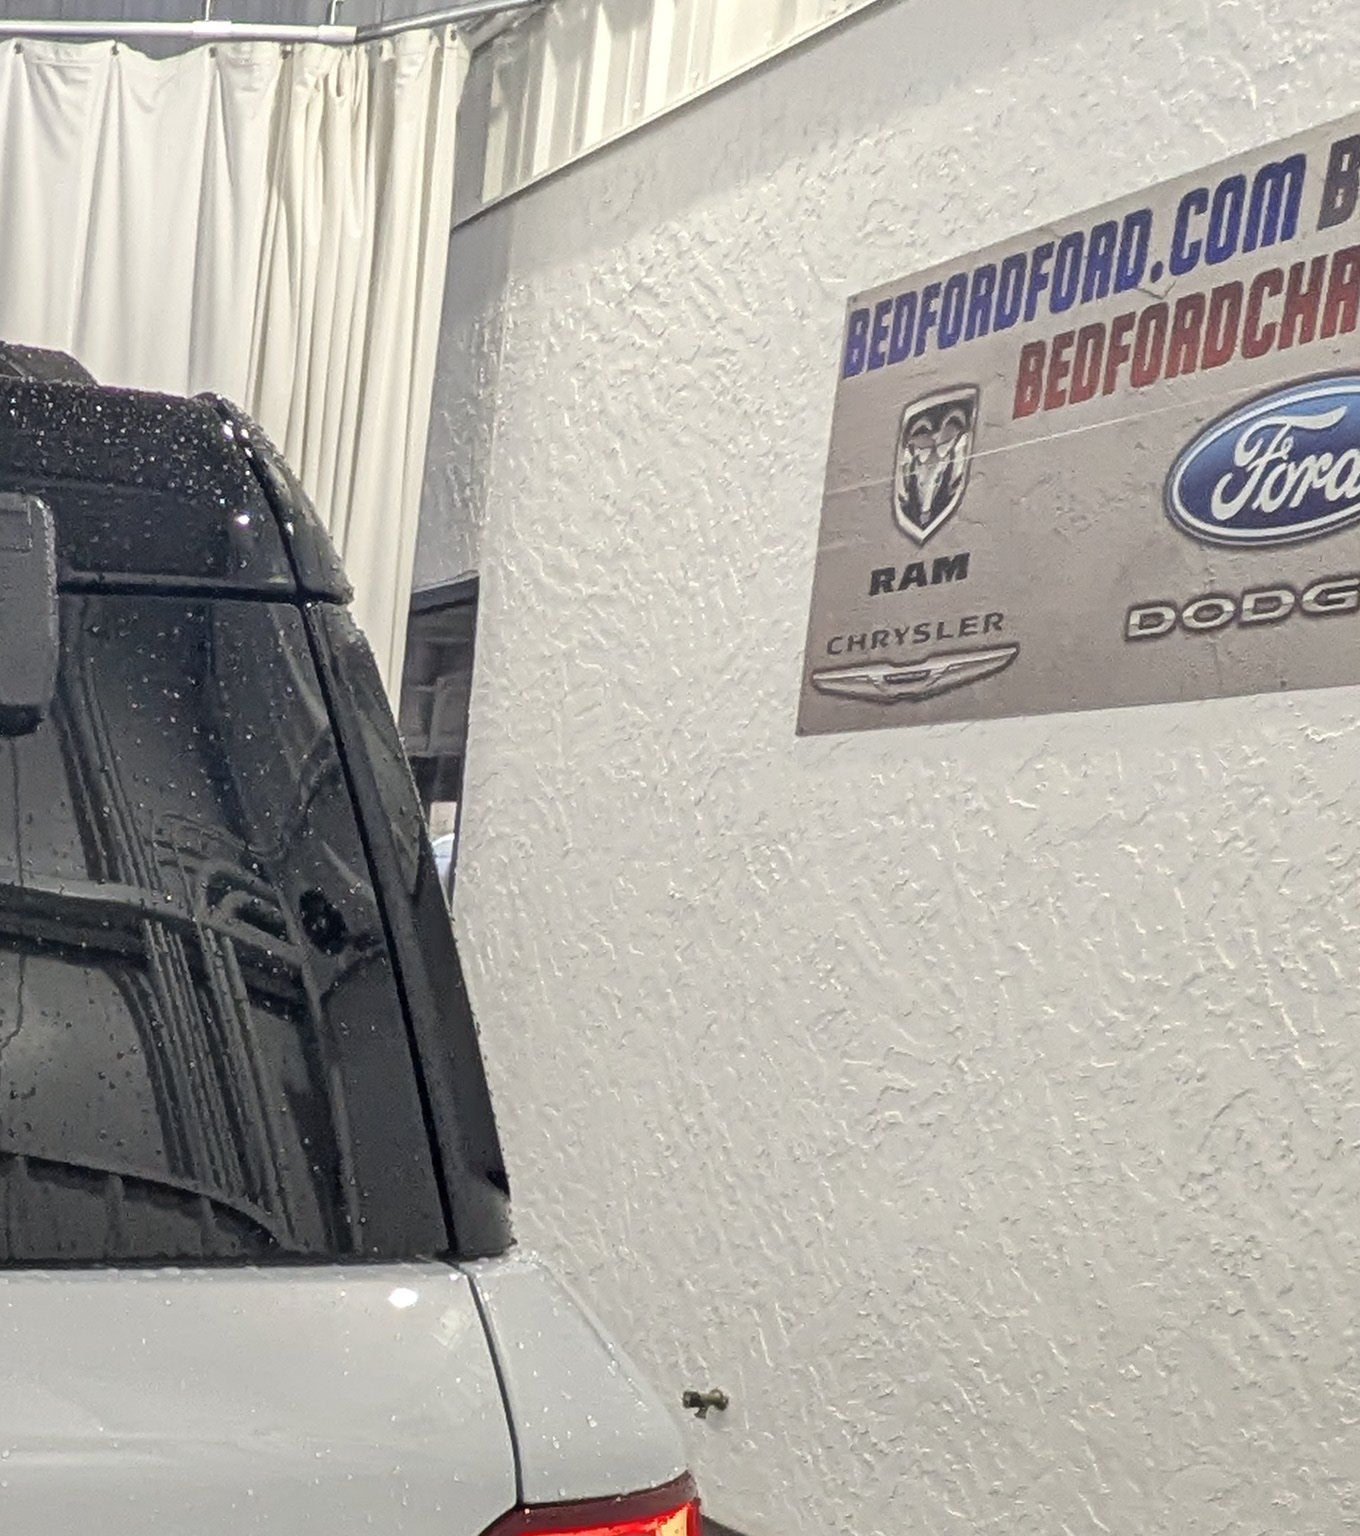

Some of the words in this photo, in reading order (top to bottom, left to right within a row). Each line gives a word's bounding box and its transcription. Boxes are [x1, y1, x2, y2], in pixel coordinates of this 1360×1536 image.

[842, 153, 1307, 379] BEDFORDFORD.COM
[868, 552, 971, 597] RAM
[826, 611, 1005, 655] CHRYSLER
